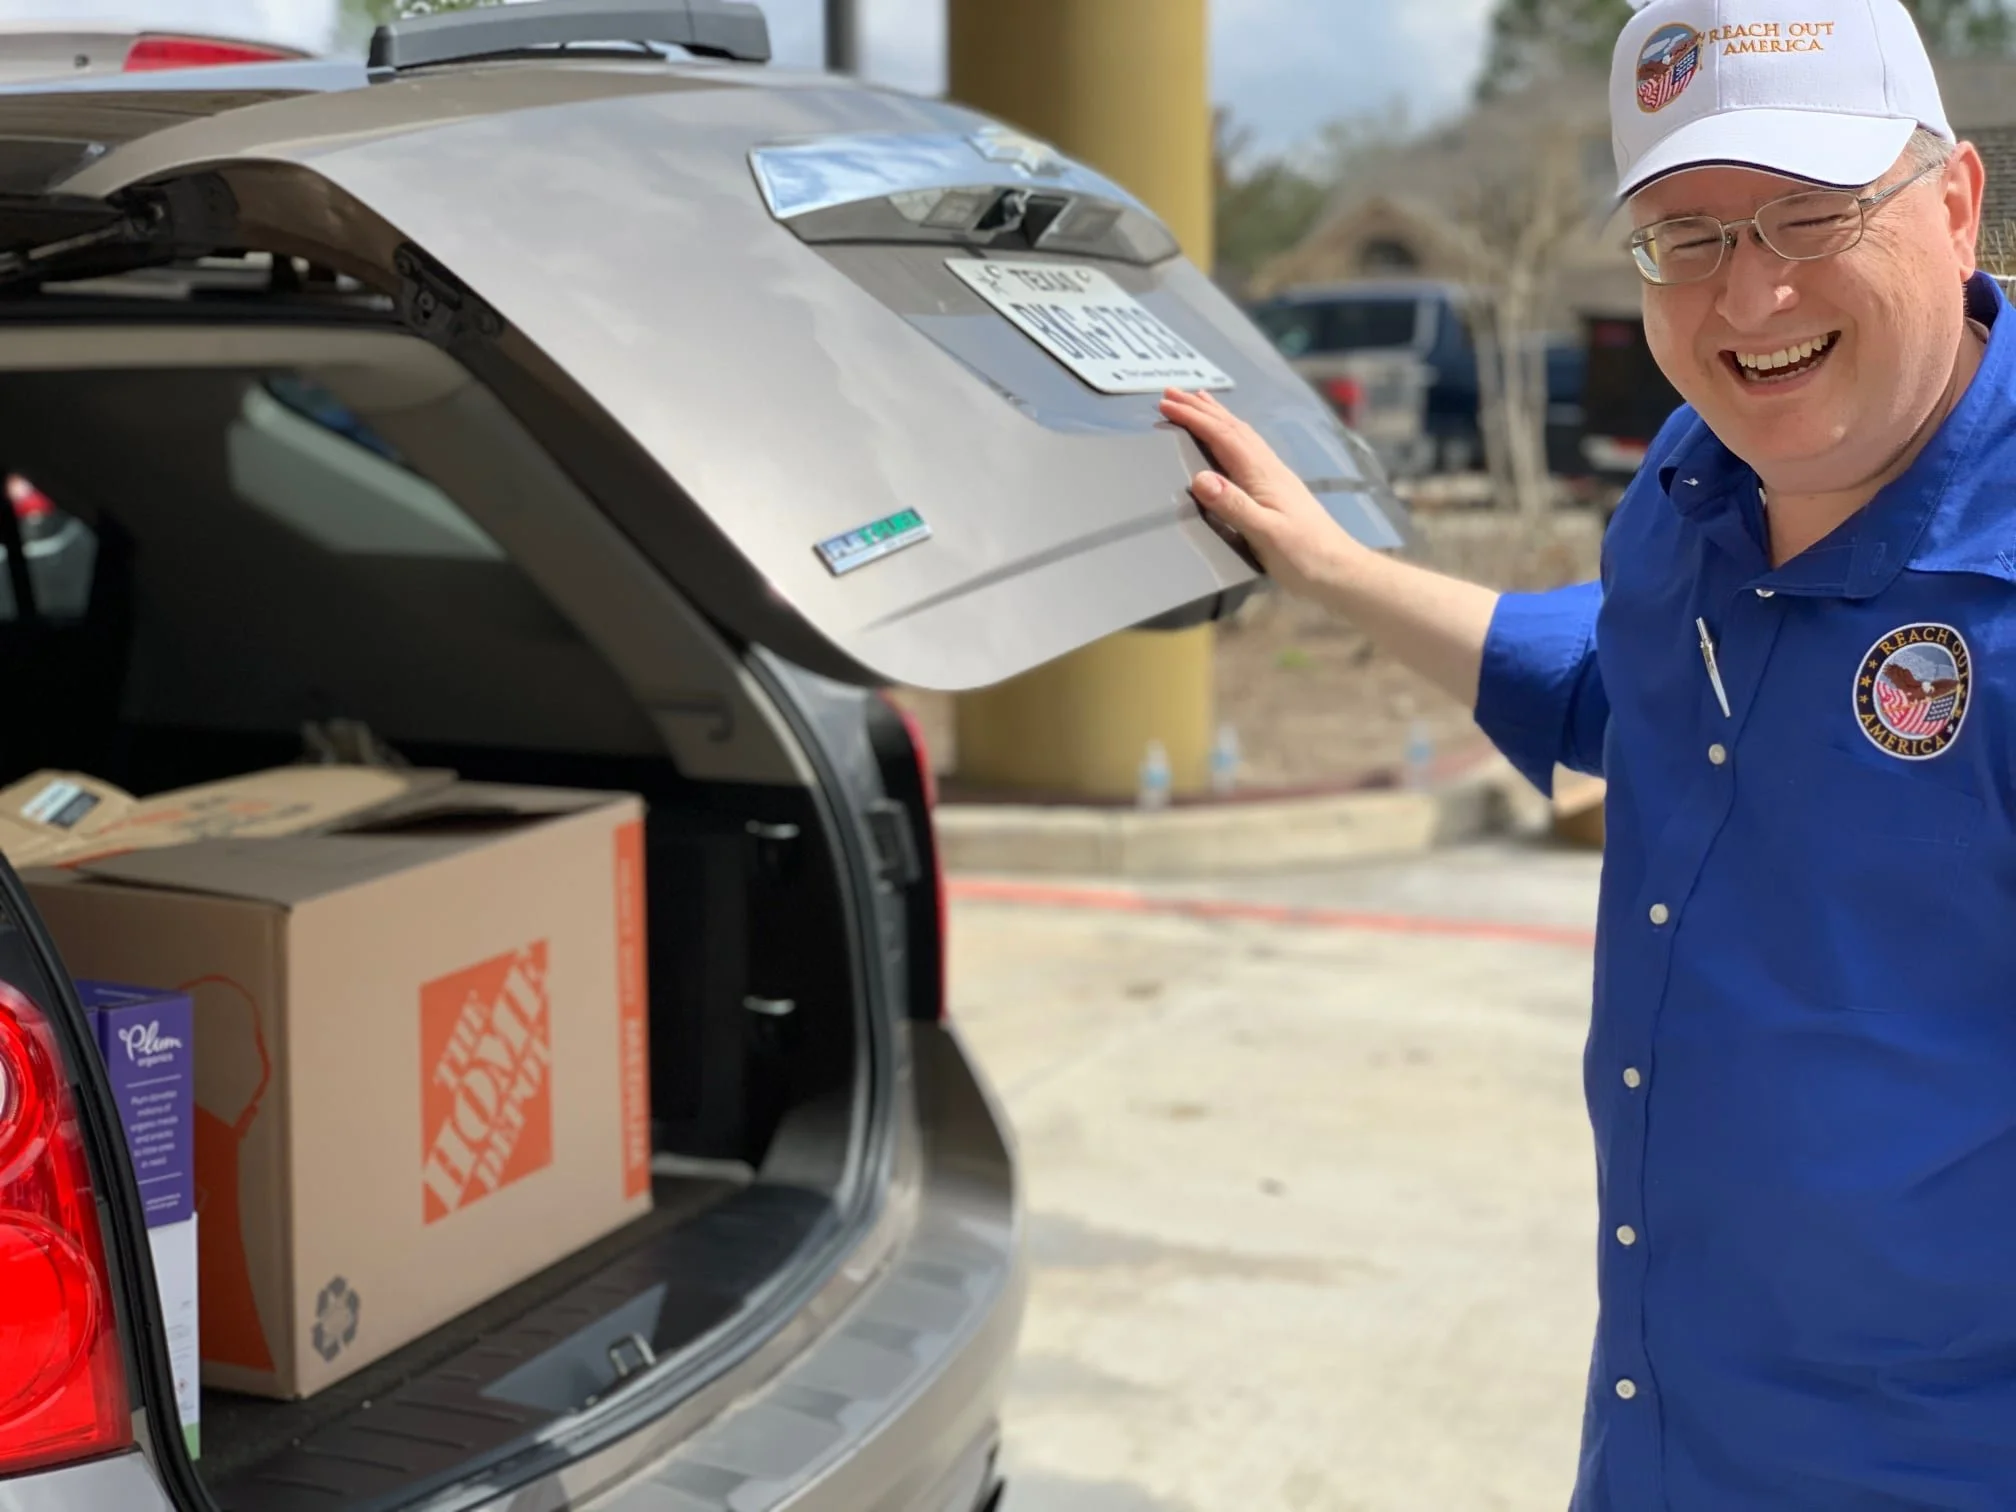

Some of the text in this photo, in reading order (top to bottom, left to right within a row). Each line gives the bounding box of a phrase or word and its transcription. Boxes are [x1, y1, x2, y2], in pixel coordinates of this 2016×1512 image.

[1709, 21, 1835, 44] REACH OUT
[1723, 39, 1824, 56] AMERICA
[1880, 627, 1969, 679] REACH OUT
[1861, 713, 1946, 755] AMERICA
[118, 1020, 182, 1061] Plum
[432, 988, 490, 1094] THE
[421, 943, 551, 1212] HOME
